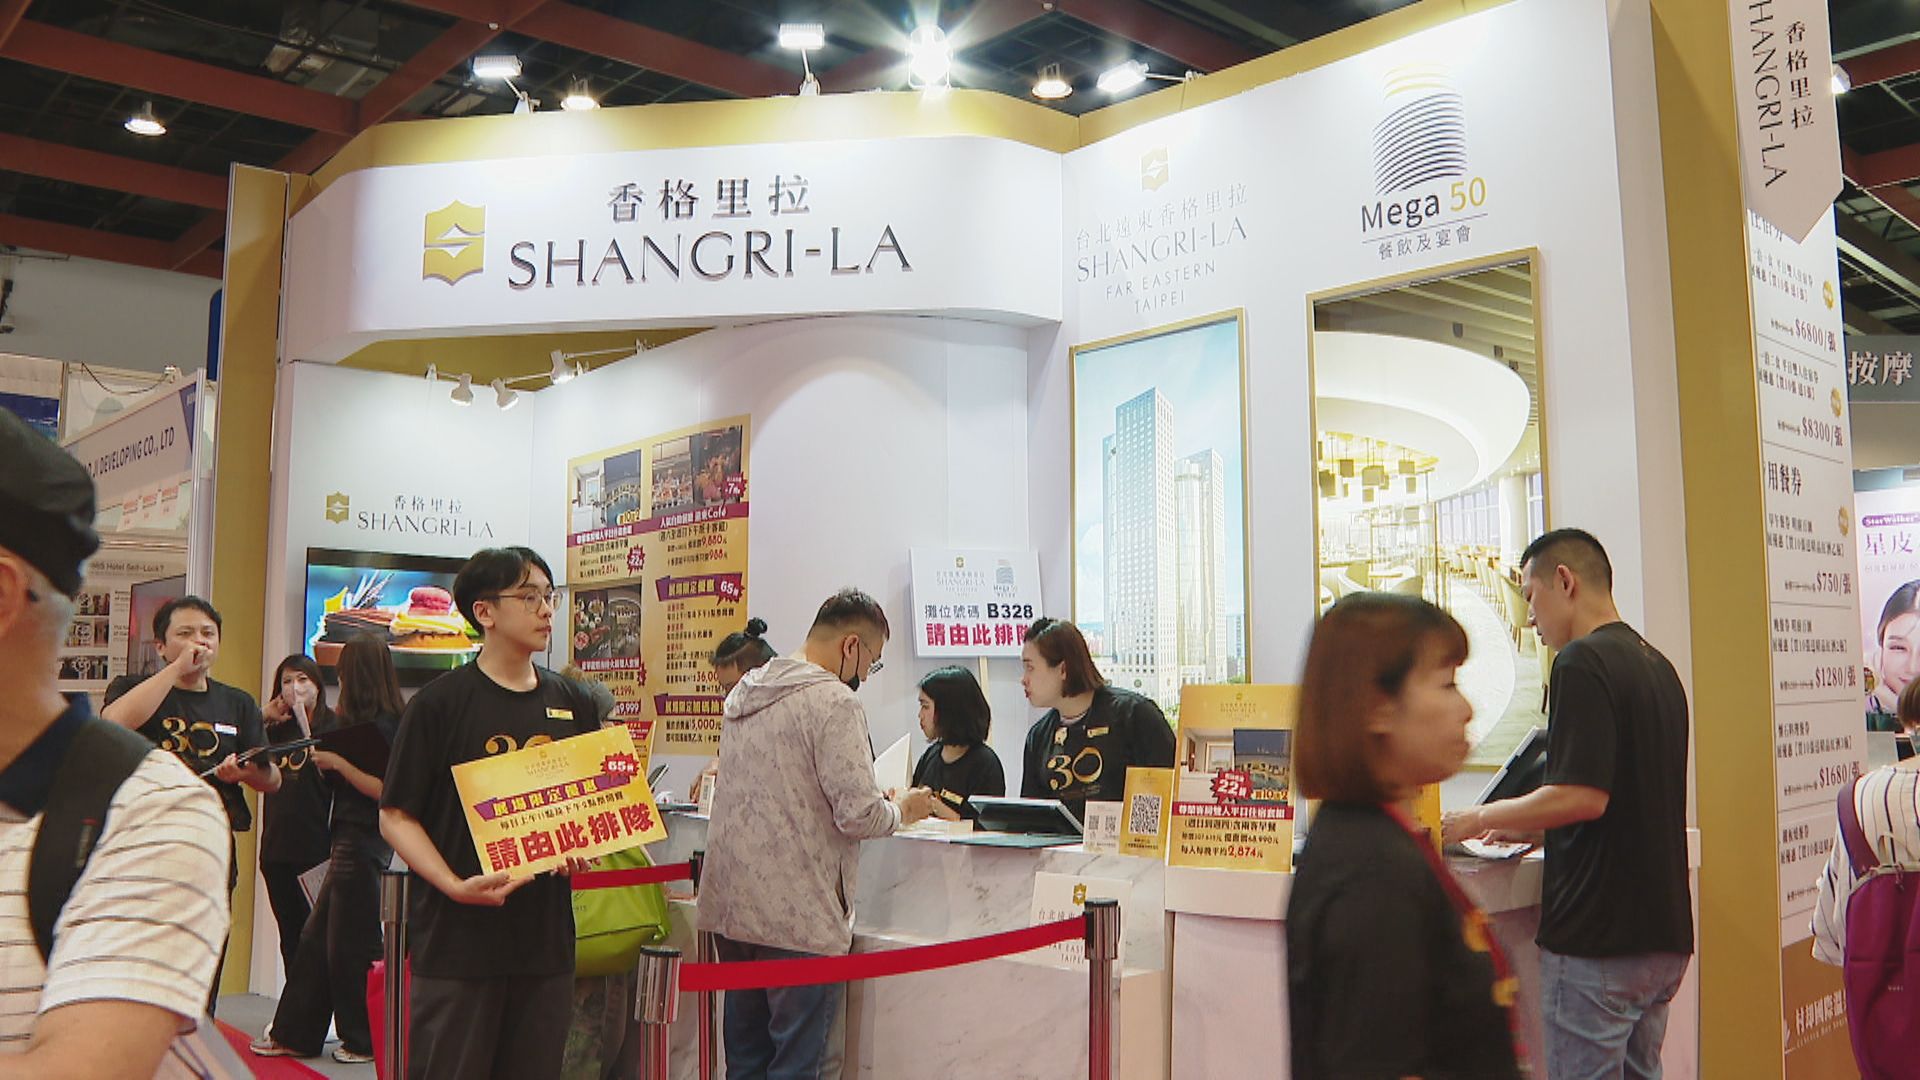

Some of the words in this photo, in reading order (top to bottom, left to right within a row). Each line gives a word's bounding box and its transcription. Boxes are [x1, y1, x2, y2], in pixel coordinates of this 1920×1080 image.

[1785, 20, 1815, 130] 香格里拉
[607, 174, 811, 224] 香格里拉
[1077, 182, 1247, 251] 台北遠東香格里拉
[1361, 194, 1440, 232] Mega
[1450, 176, 1487, 212] 50
[508, 224, 914, 290] SHANGRI-LA
[1077, 216, 1247, 282] SHANGRI-LA
[1379, 224, 1471, 261] 餐飲及宴會
[1107, 281, 1133, 301] FAR
[1142, 260, 1216, 290] EASTERN
[1136, 290, 1185, 314] TAIPEI
[1795, 318, 1837, 352] $6800/張
[1847, 350, 1914, 386] 按摩
[100, 441, 142, 475] DEVELOPING
[160, 427, 175, 450] LTD
[1802, 416, 1843, 446] $8300/張
[394, 495, 462, 513] 香格里拉
[357, 511, 494, 538] SHANGRI-LA
[1816, 571, 1852, 597] $750/張
[925, 605, 979, 619] 攤位號碼
[987, 603, 1033, 619] B328
[1815, 665, 1856, 689] $1280/張
[161, 717, 220, 757] 30
[1047, 746, 1104, 791] 30
[486, 802, 654, 872] 請由此排隊
[1795, 988, 1847, 1034] 村却國際溫
